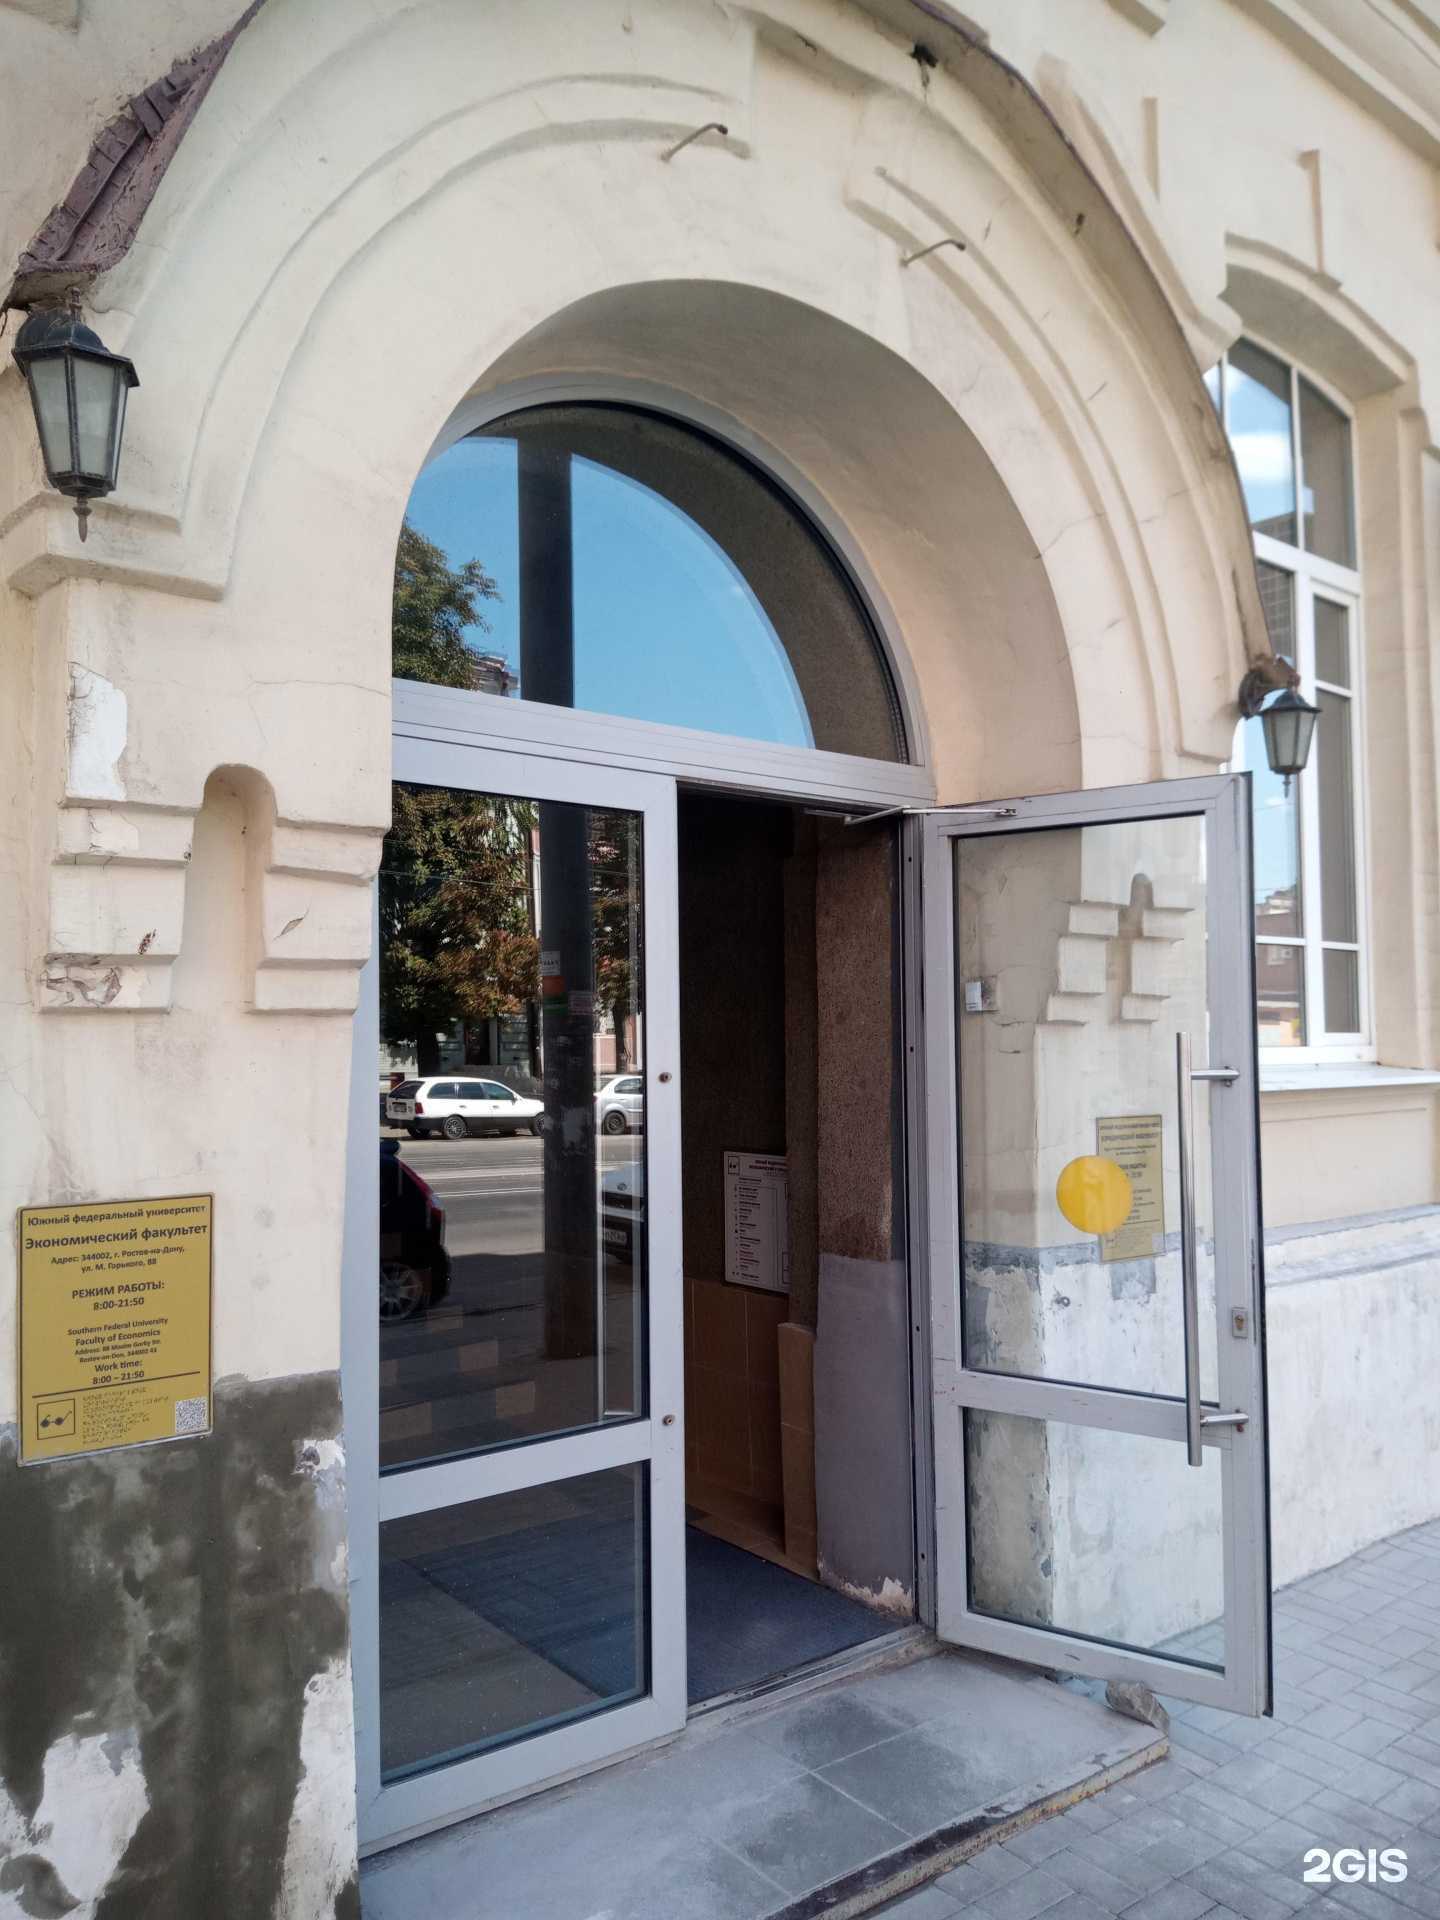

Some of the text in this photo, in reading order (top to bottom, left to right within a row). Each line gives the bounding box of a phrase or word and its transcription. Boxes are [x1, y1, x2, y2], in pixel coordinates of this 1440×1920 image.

[28, 1205, 206, 1226] Южный федеральный университет
[25, 1225, 208, 1249] Экономический факультет
[72, 1281, 165, 1299] РЕЖИМ РАБОТЫ:
[93, 1297, 145, 1311] 8:00-21:50
[67, 1317, 168, 1336] Southern Federal University
[75, 1329, 161, 1346] Faculty of Economics
[94, 1359, 143, 1373] Work time:
[92, 1375, 112, 1385] 8:00
[120, 1371, 145, 1381] 21:50
